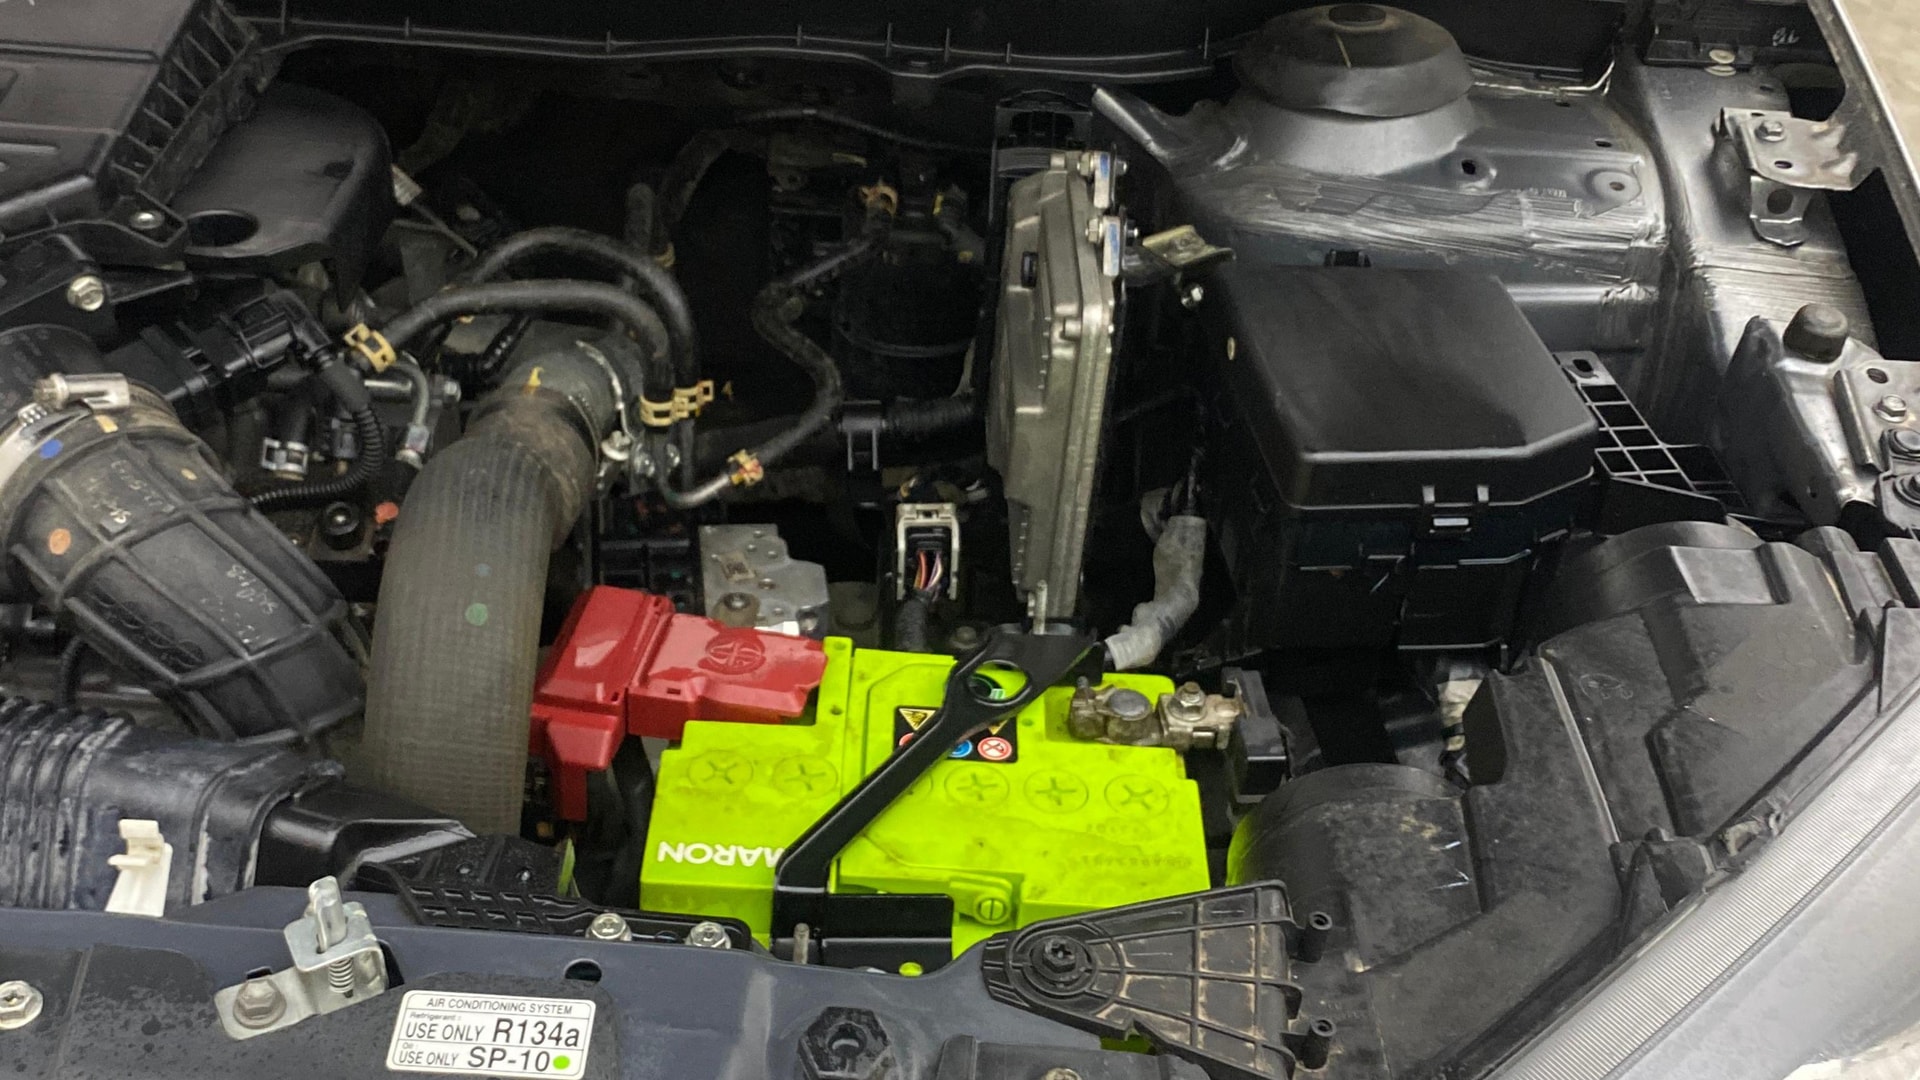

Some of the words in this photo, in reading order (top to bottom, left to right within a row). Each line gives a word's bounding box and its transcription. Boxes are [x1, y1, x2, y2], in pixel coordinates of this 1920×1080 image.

[427, 998, 446, 1008] AIR
[448, 999, 526, 1013] CONDITIONING
[529, 1003, 573, 1014] SYSTEM
[406, 1022, 438, 1039] USE
[442, 1025, 484, 1042] ONLY
[492, 1018, 580, 1047] R134a
[399, 1051, 424, 1064] USE
[426, 1052, 459, 1066] ONLY
[467, 1046, 550, 1072] SP-10
